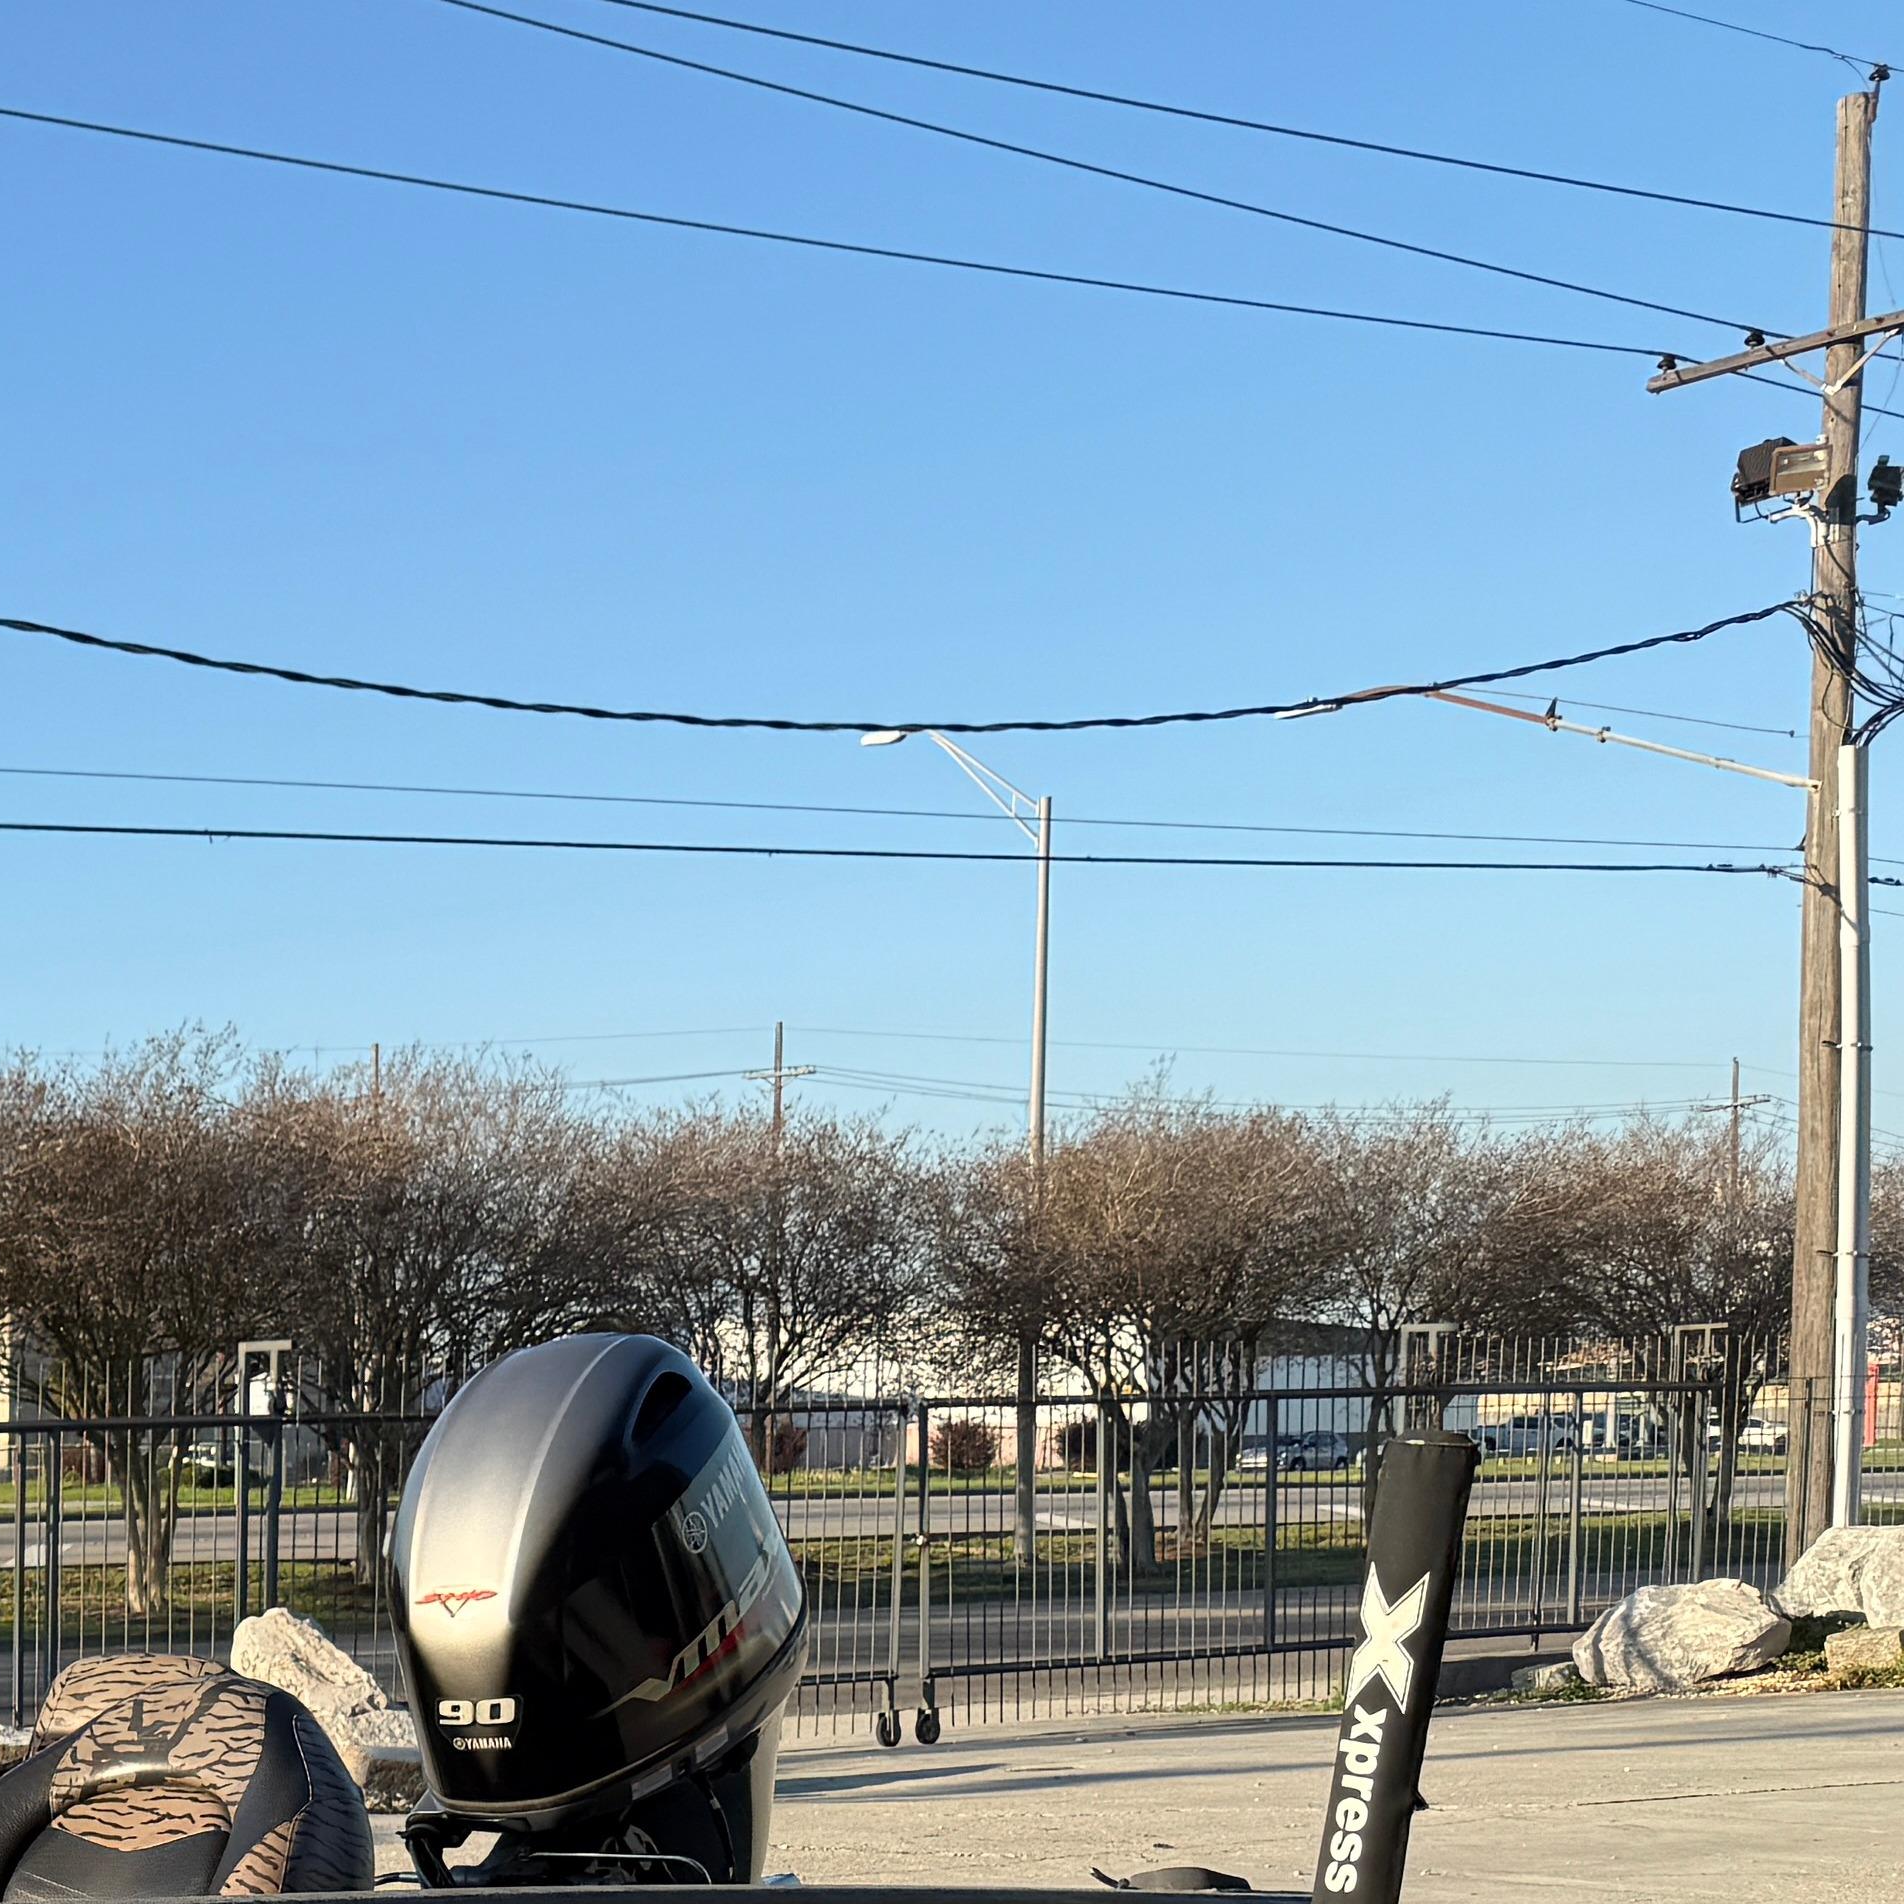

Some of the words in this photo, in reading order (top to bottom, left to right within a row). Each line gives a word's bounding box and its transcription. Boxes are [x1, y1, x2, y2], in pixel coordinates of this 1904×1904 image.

[438, 1697, 516, 1726] 90
[465, 1736, 513, 1751] YAMAHA
[1324, 1703, 1387, 1893] xpress
